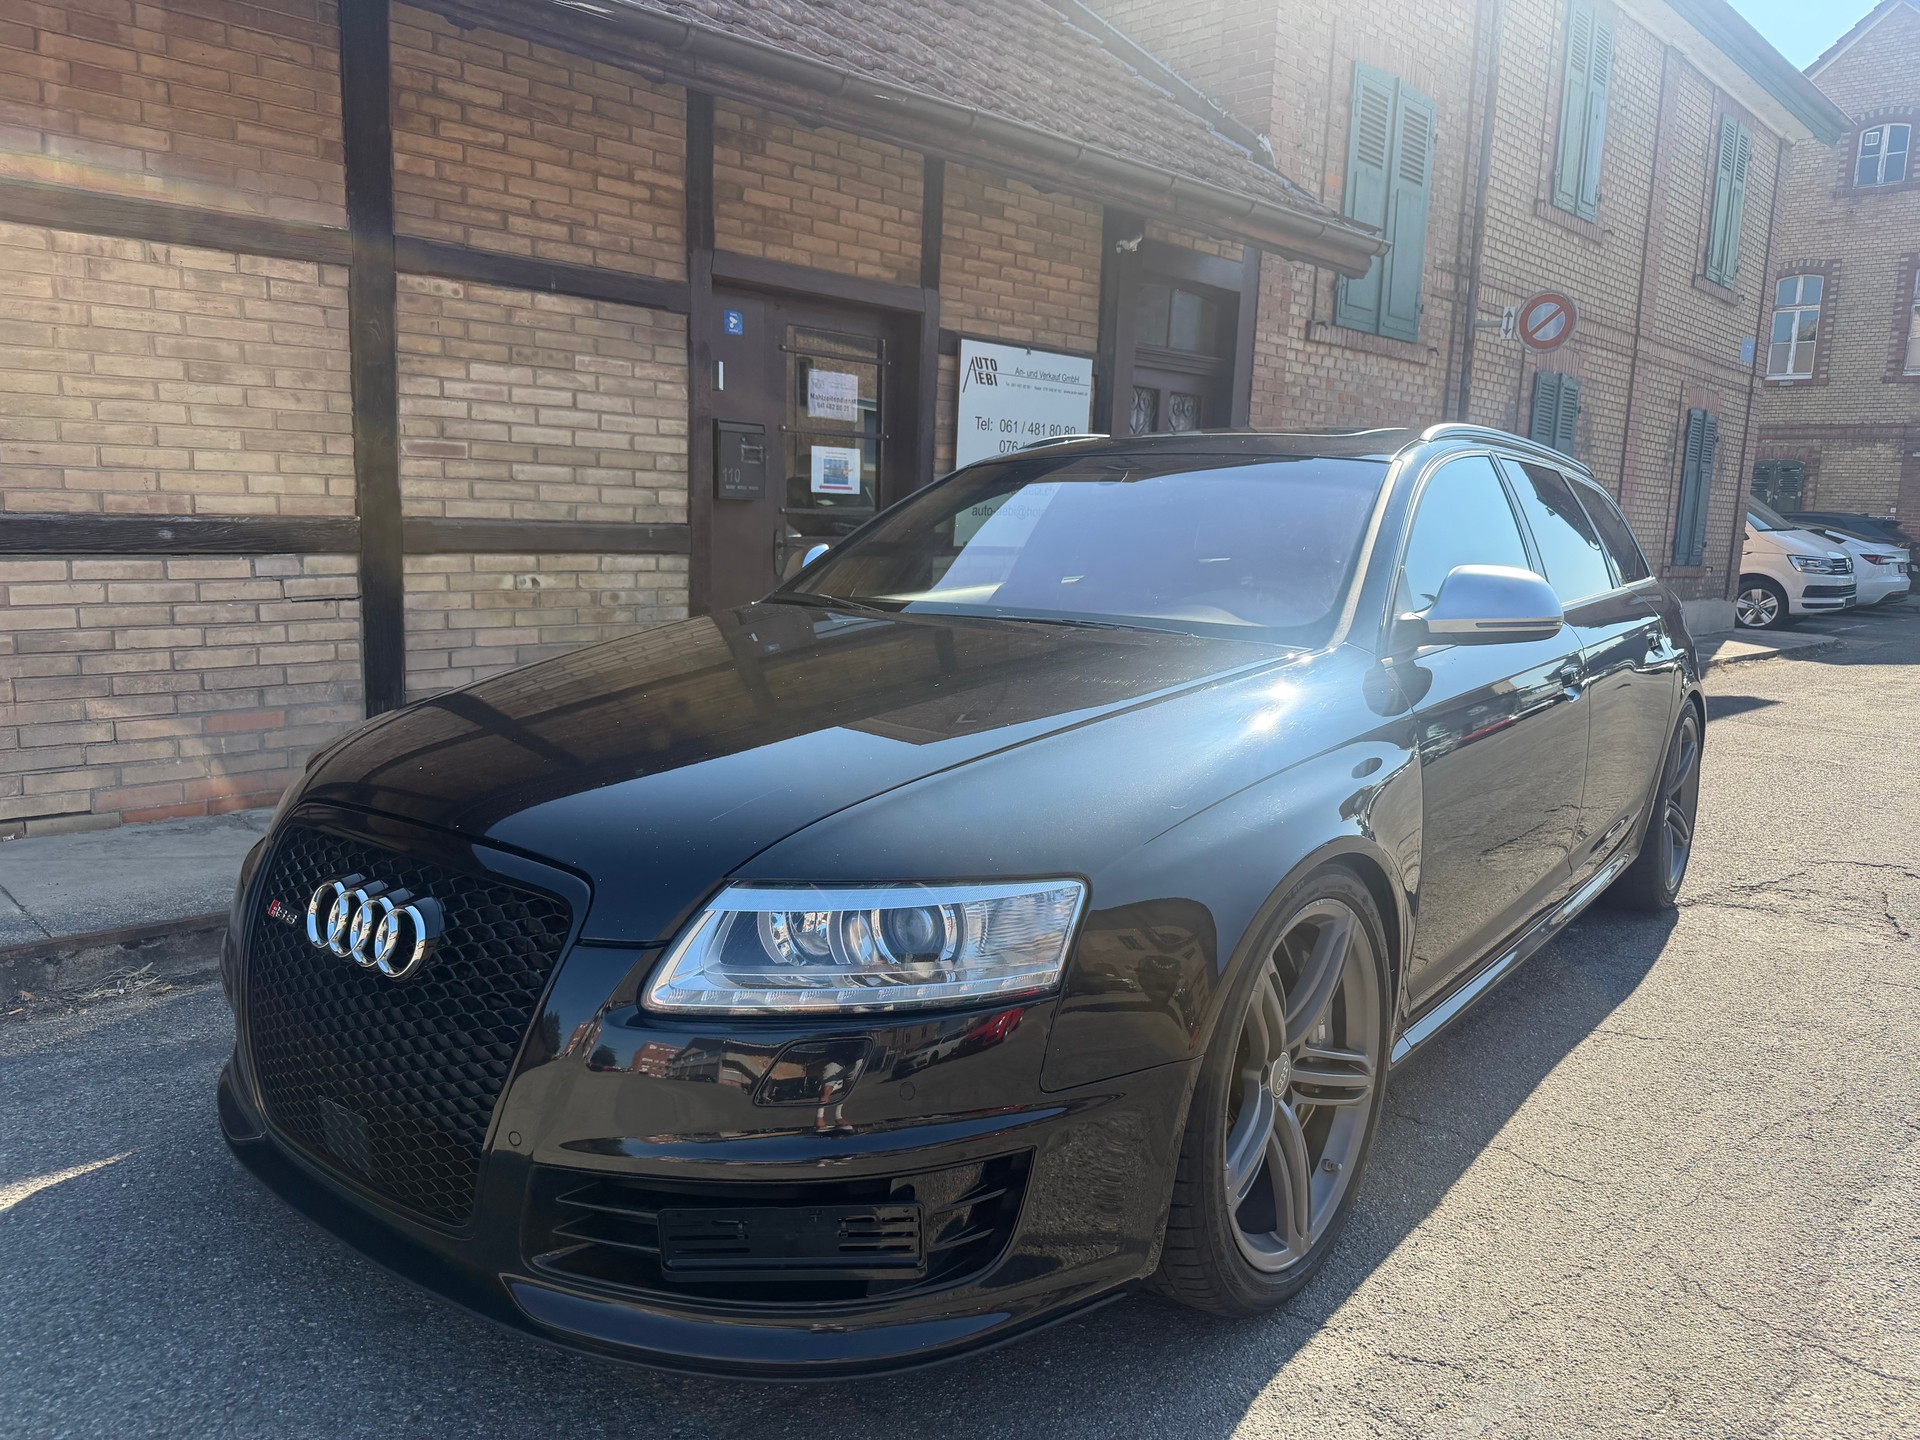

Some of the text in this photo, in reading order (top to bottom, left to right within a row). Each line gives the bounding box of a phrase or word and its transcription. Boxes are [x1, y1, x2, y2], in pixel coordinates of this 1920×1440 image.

[1015, 367, 1080, 384] An- und Verkauf GmbH
[975, 416, 993, 431] Tel:
[1000, 419, 1018, 434] 061
[1028, 422, 1045, 436] 481
[1049, 424, 1062, 437] 80
[999, 440, 1018, 453] 076
[723, 467, 741, 483] 110
